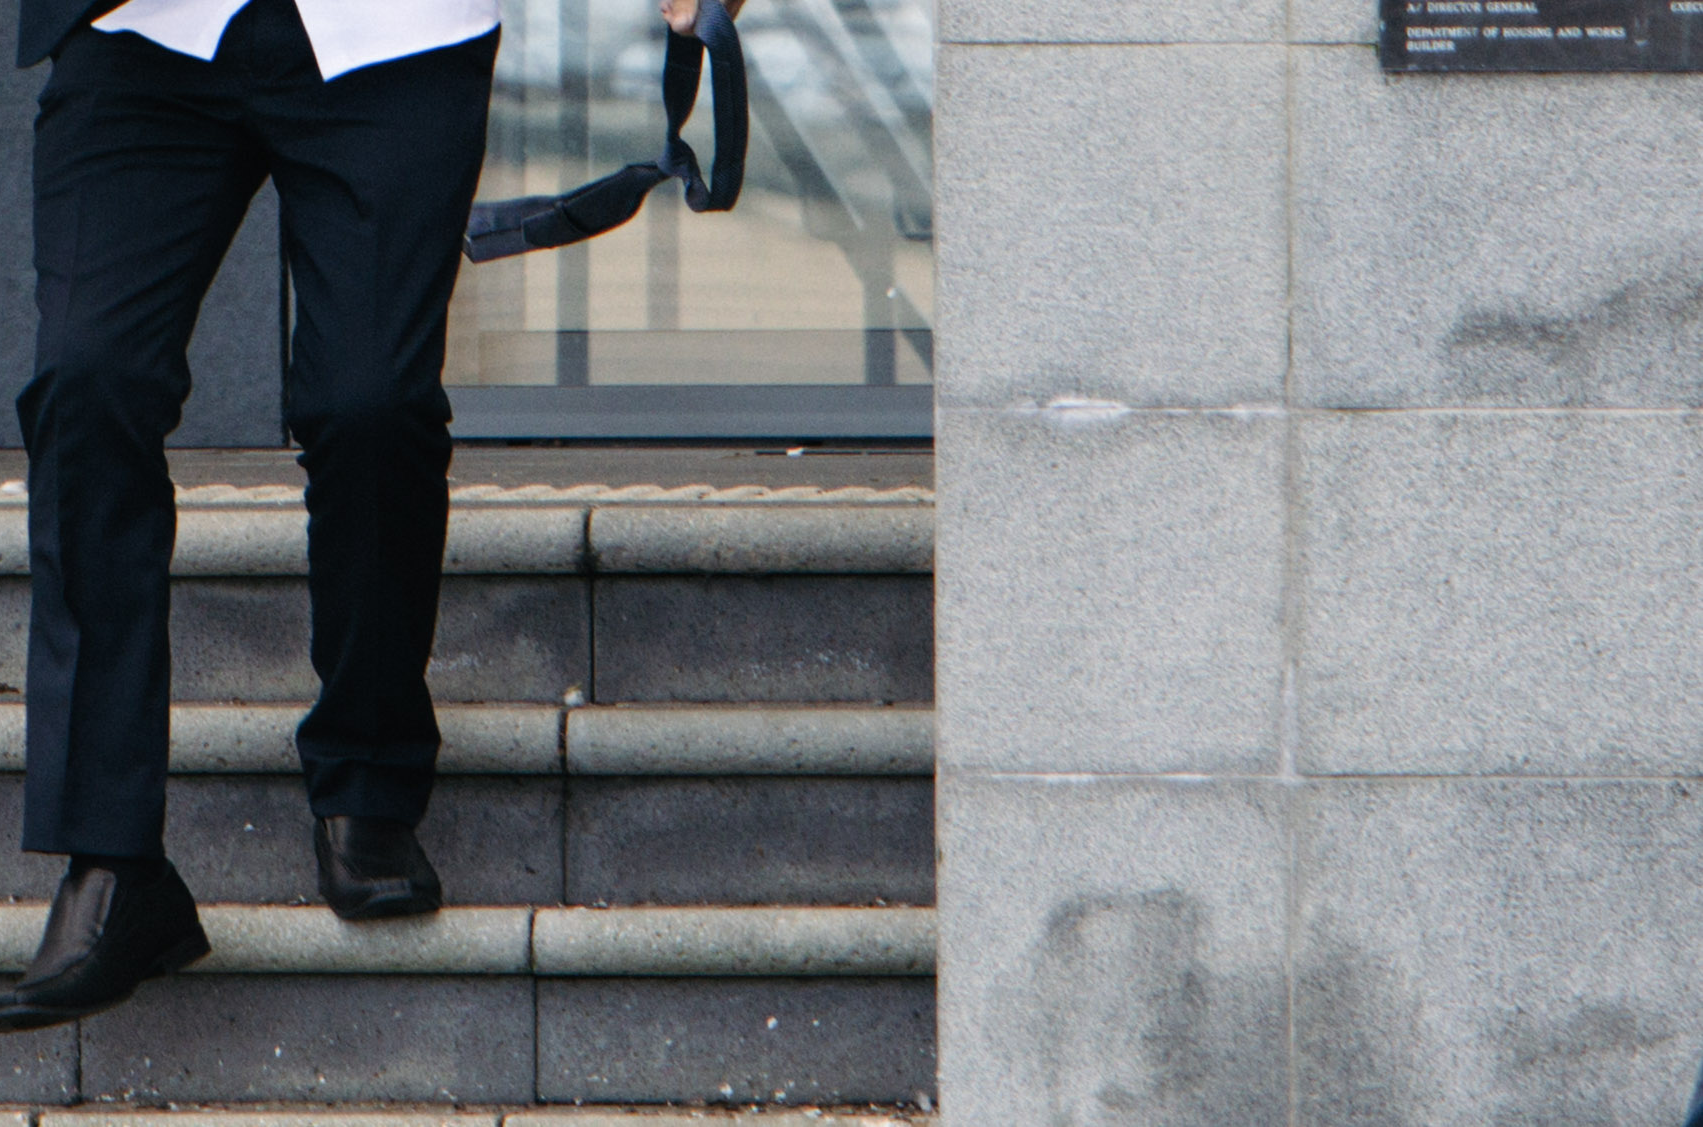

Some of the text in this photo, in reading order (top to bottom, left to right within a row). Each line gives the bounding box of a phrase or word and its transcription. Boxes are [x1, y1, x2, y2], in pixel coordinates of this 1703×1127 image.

[1427, 1, 1482, 14] DIRECTOR
[1486, 1, 1539, 14] GENERAL
[1407, 26, 1627, 40] DEPARTMENT OF HOUSING AND WORKS
[1407, 40, 1456, 53] BUILDER
